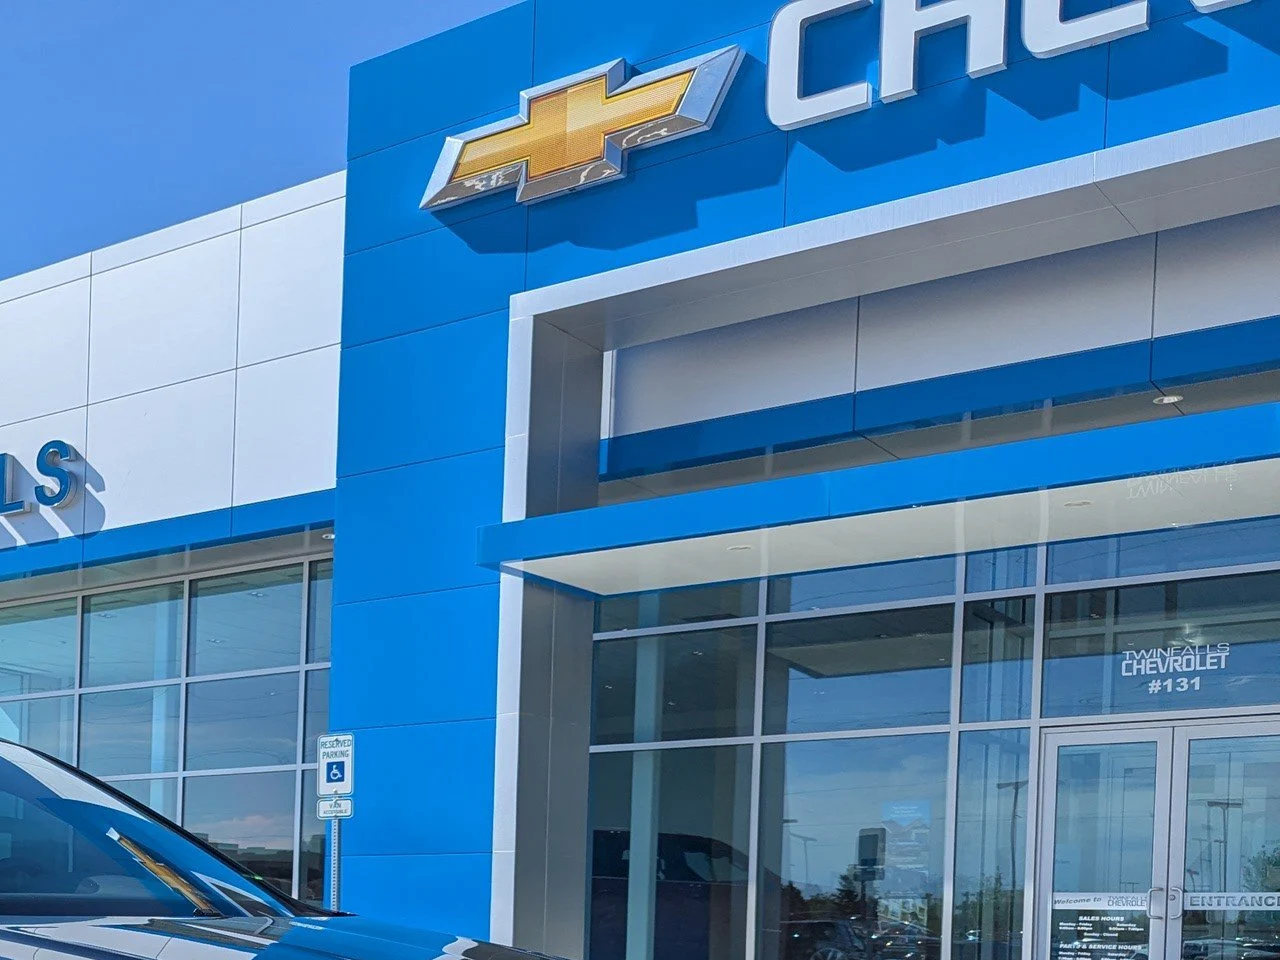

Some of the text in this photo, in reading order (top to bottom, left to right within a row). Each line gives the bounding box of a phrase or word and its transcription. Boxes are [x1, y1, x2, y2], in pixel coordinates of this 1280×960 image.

[766, 0, 1251, 130] CH
[1121, 652, 1230, 677] CHEVROLET
[1148, 676, 1201, 694] #131
[320, 739, 352, 749] RESERVED
[322, 750, 350, 759] PARKING
[1054, 897, 1091, 905] Welcome
